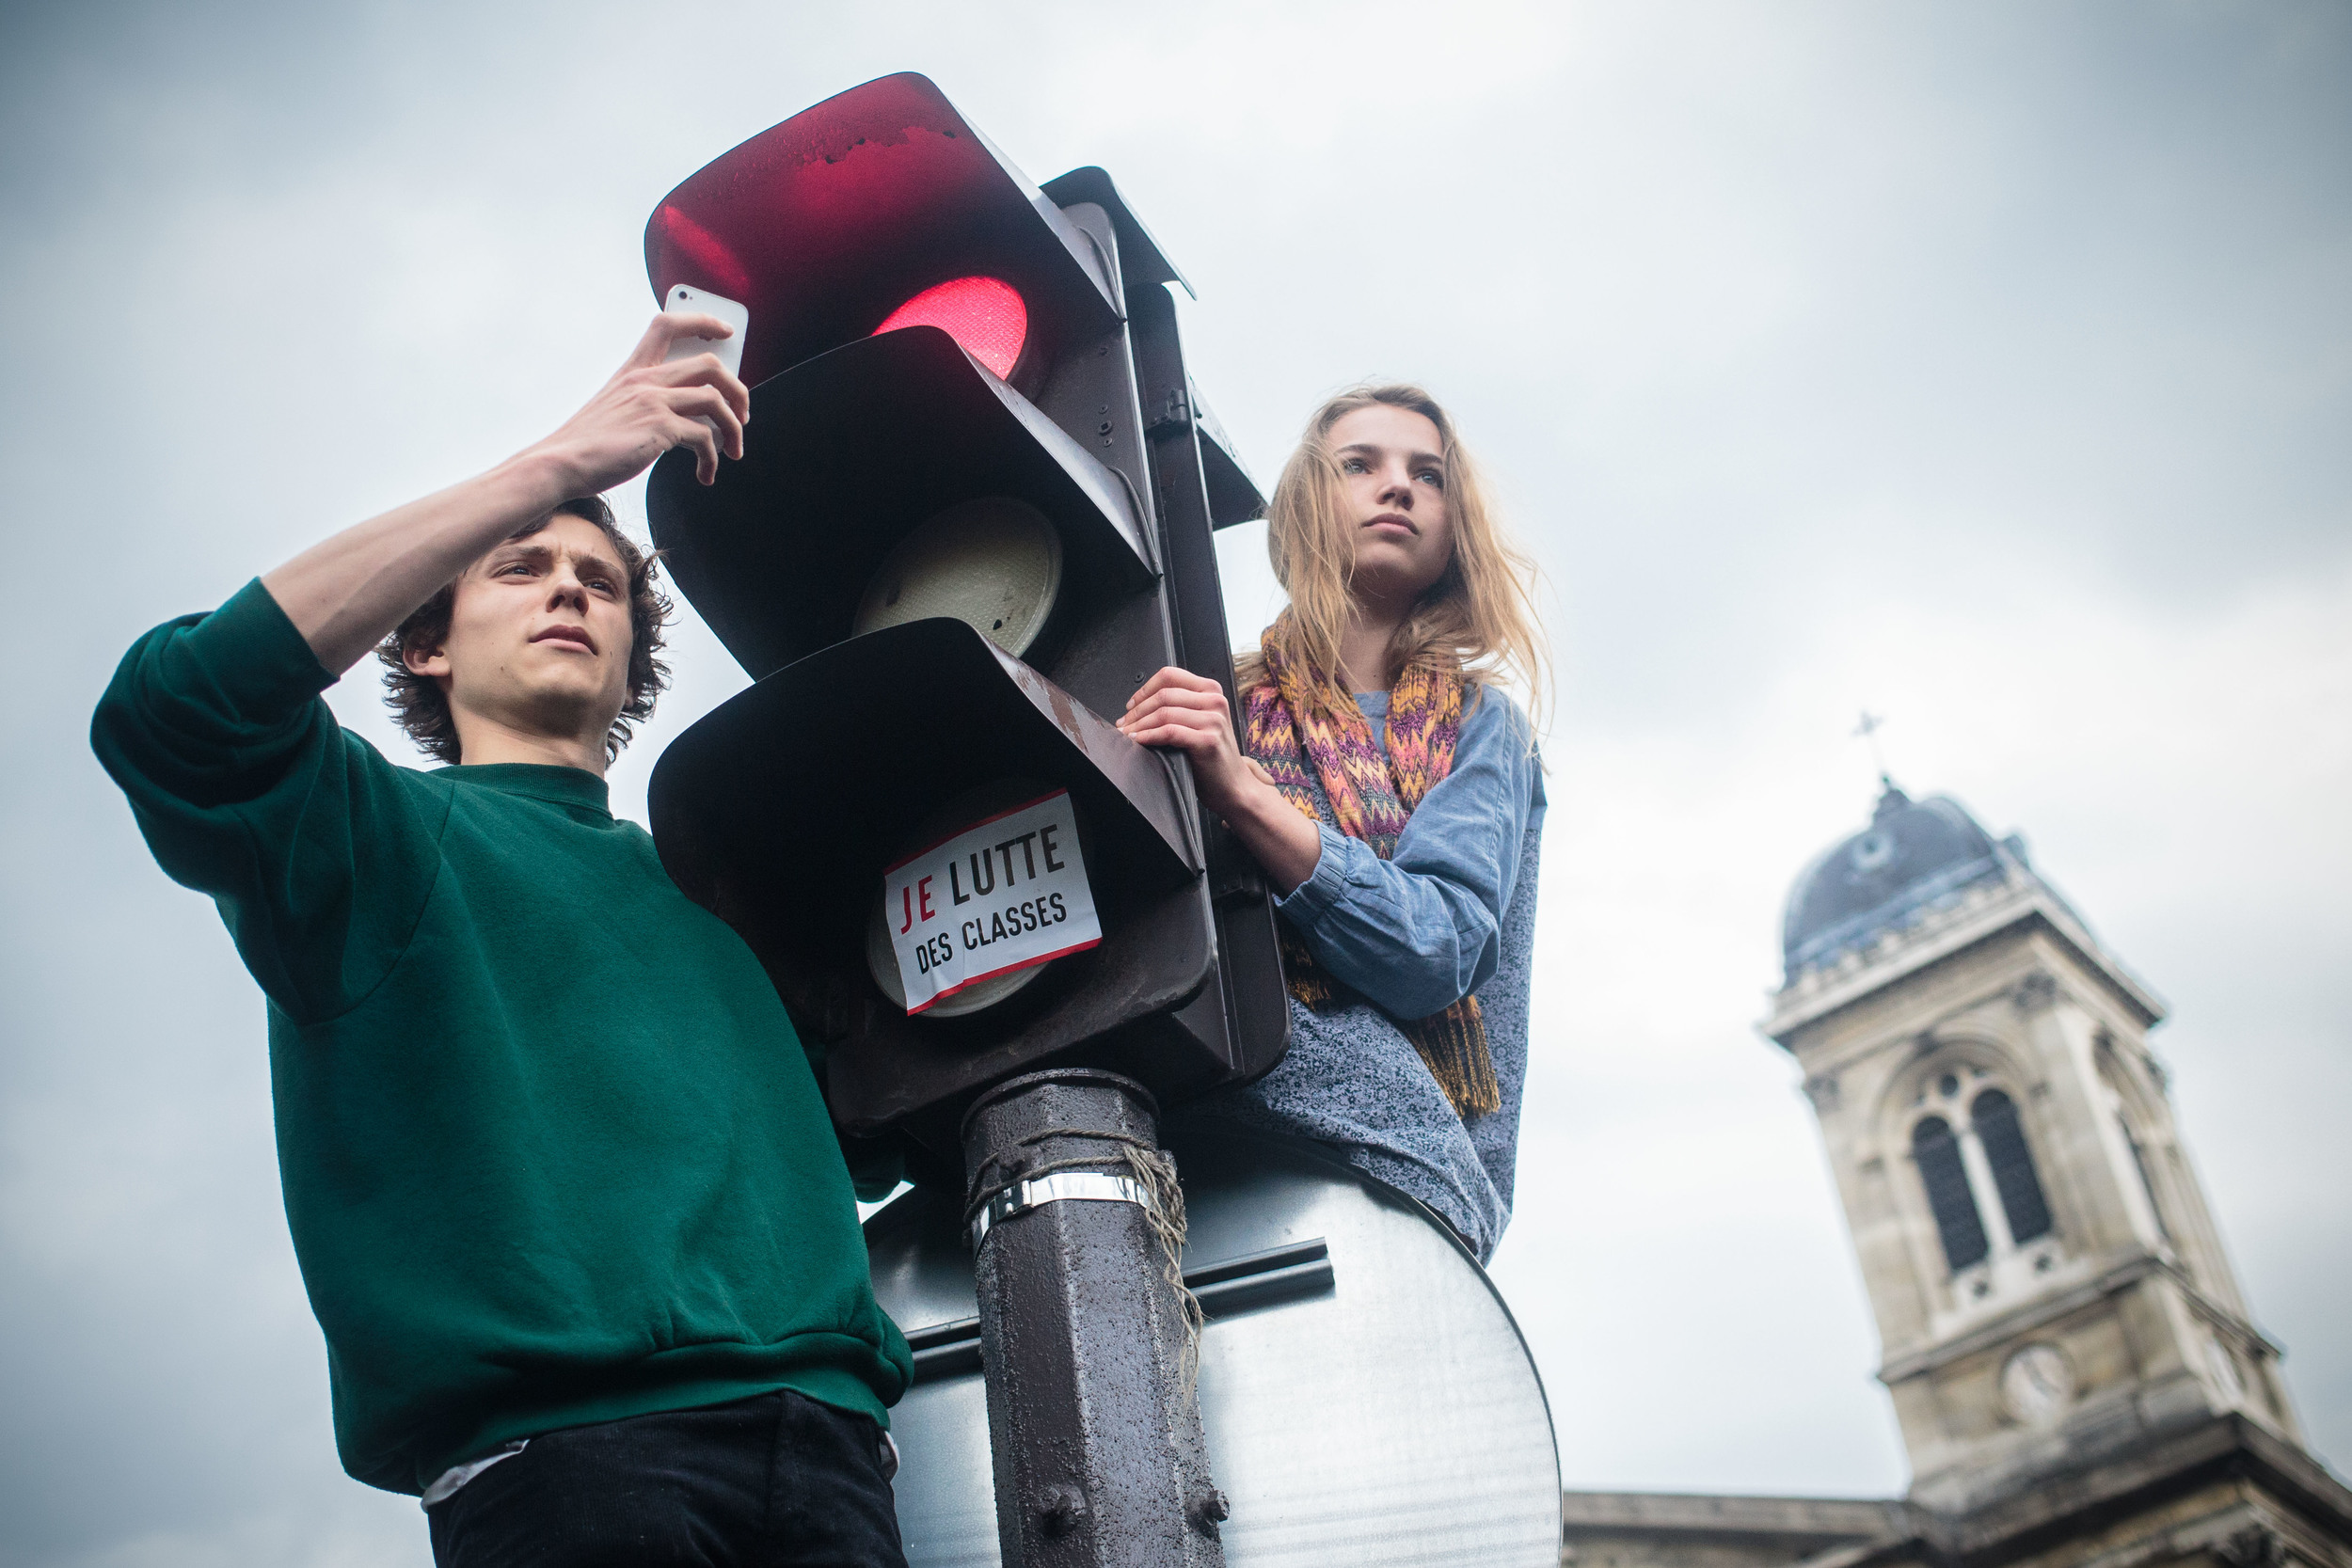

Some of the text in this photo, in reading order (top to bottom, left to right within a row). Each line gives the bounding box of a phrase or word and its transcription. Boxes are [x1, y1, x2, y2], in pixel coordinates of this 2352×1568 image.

[900, 824, 1065, 935] JE LUTTE
[915, 892, 1067, 974] DES CLASSES
